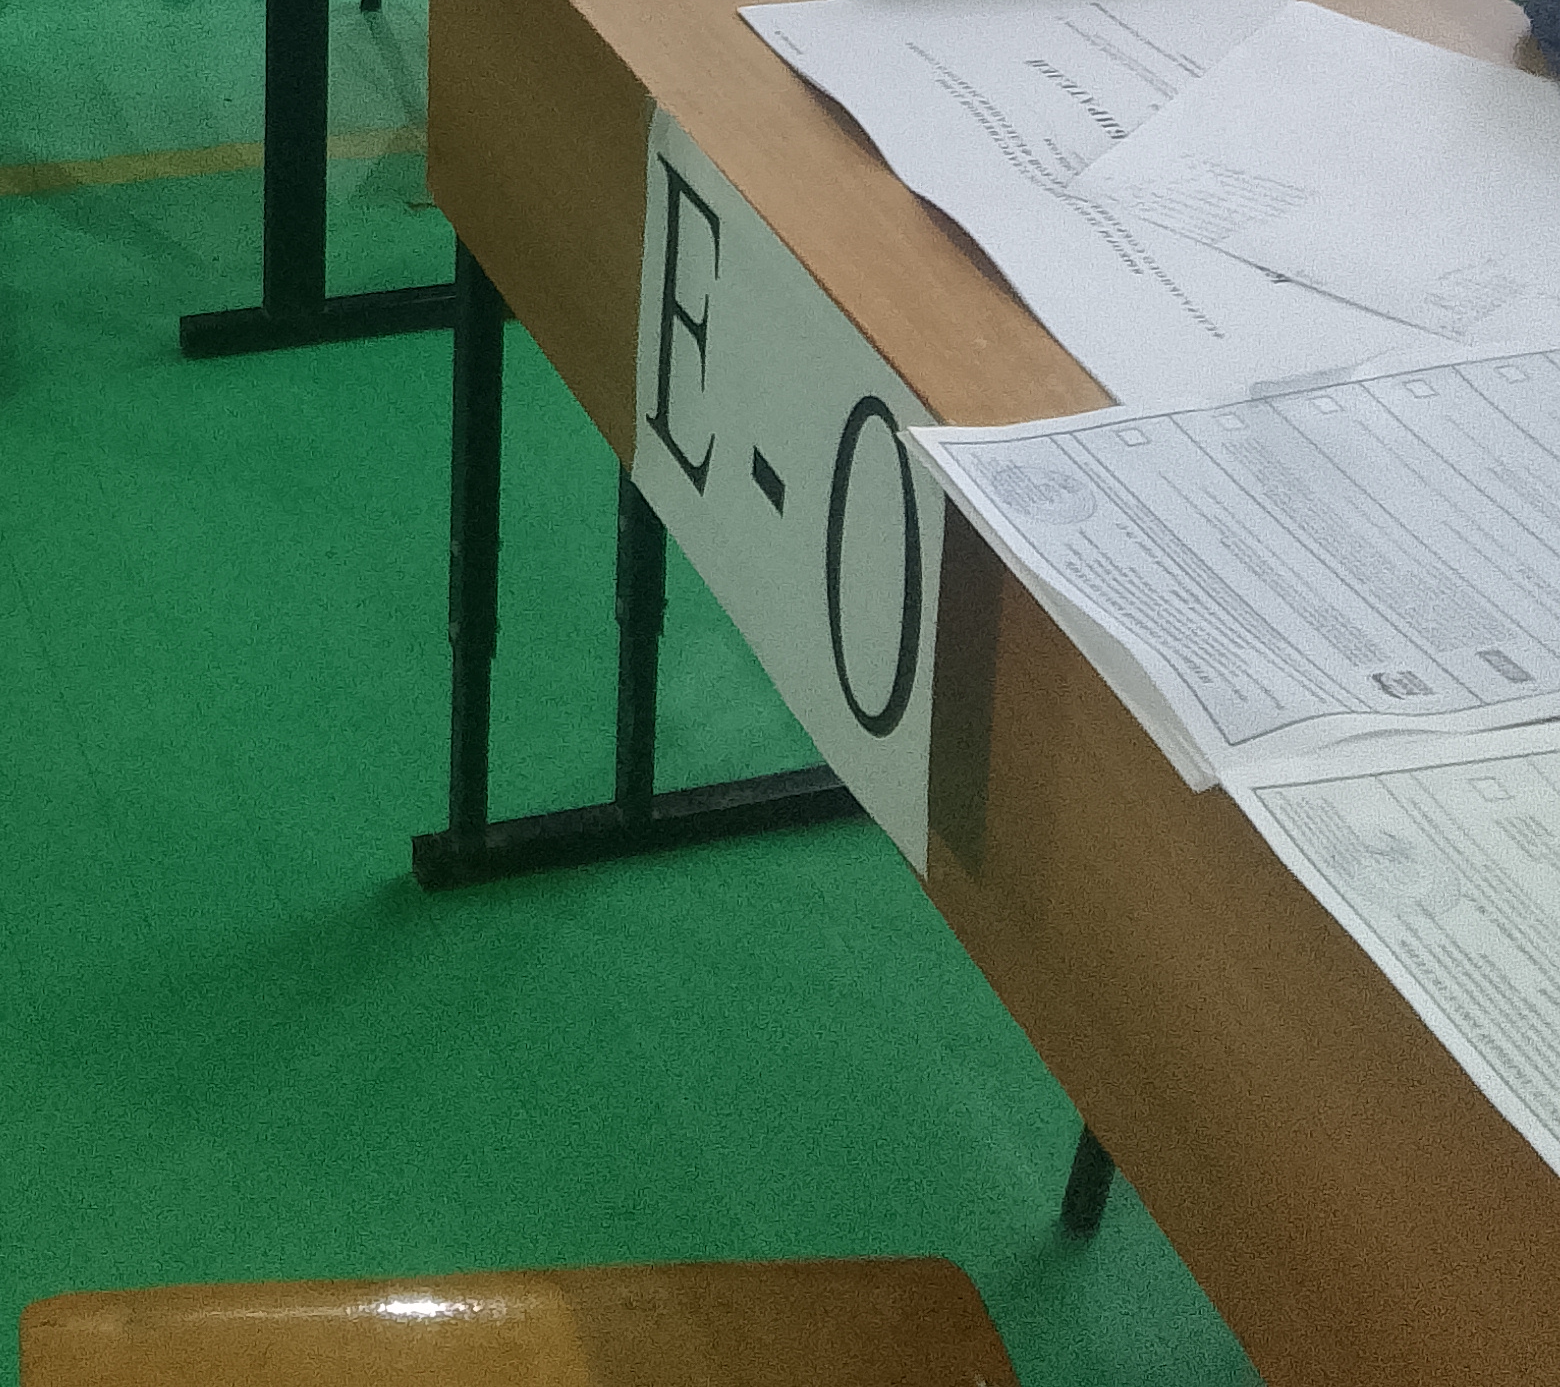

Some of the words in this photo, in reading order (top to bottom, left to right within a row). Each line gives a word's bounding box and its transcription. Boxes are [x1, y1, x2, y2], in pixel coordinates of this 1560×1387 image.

[1023, 58, 1129, 141] БИРАТЕЛЕЙ
[646, 152, 721, 497] Е
[826, 394, 923, 739] О
